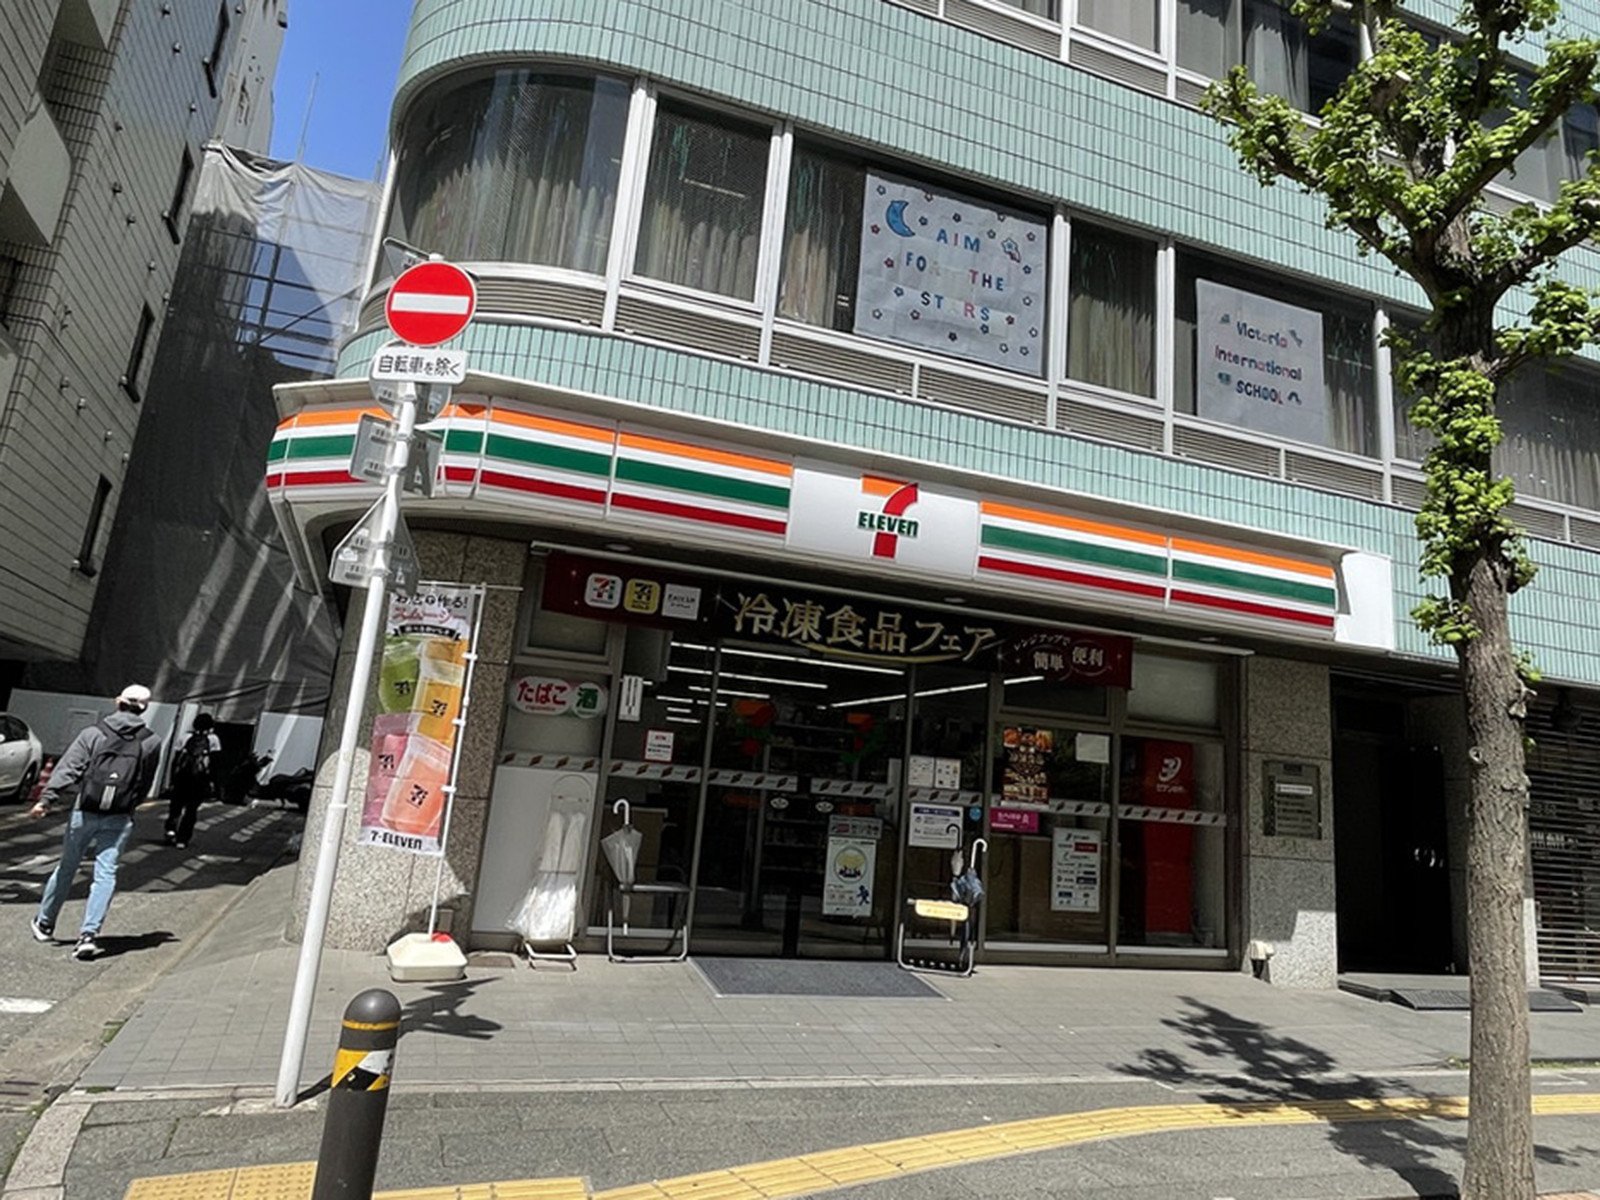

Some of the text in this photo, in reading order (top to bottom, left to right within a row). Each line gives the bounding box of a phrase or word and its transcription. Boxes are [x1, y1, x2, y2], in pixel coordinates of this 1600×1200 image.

[936, 229, 981, 253] AIM
[969, 268, 1004, 292] THE
[1236, 321, 1288, 348] Victoria
[378, 354, 461, 377] 自転車を除く
[1215, 345, 1302, 381] International
[1235, 380, 1284, 405] SCHOOL
[734, 592, 997, 663] 冷凍食品フェア
[517, 681, 568, 707] たばこ
[576, 687, 598, 710] 酒
